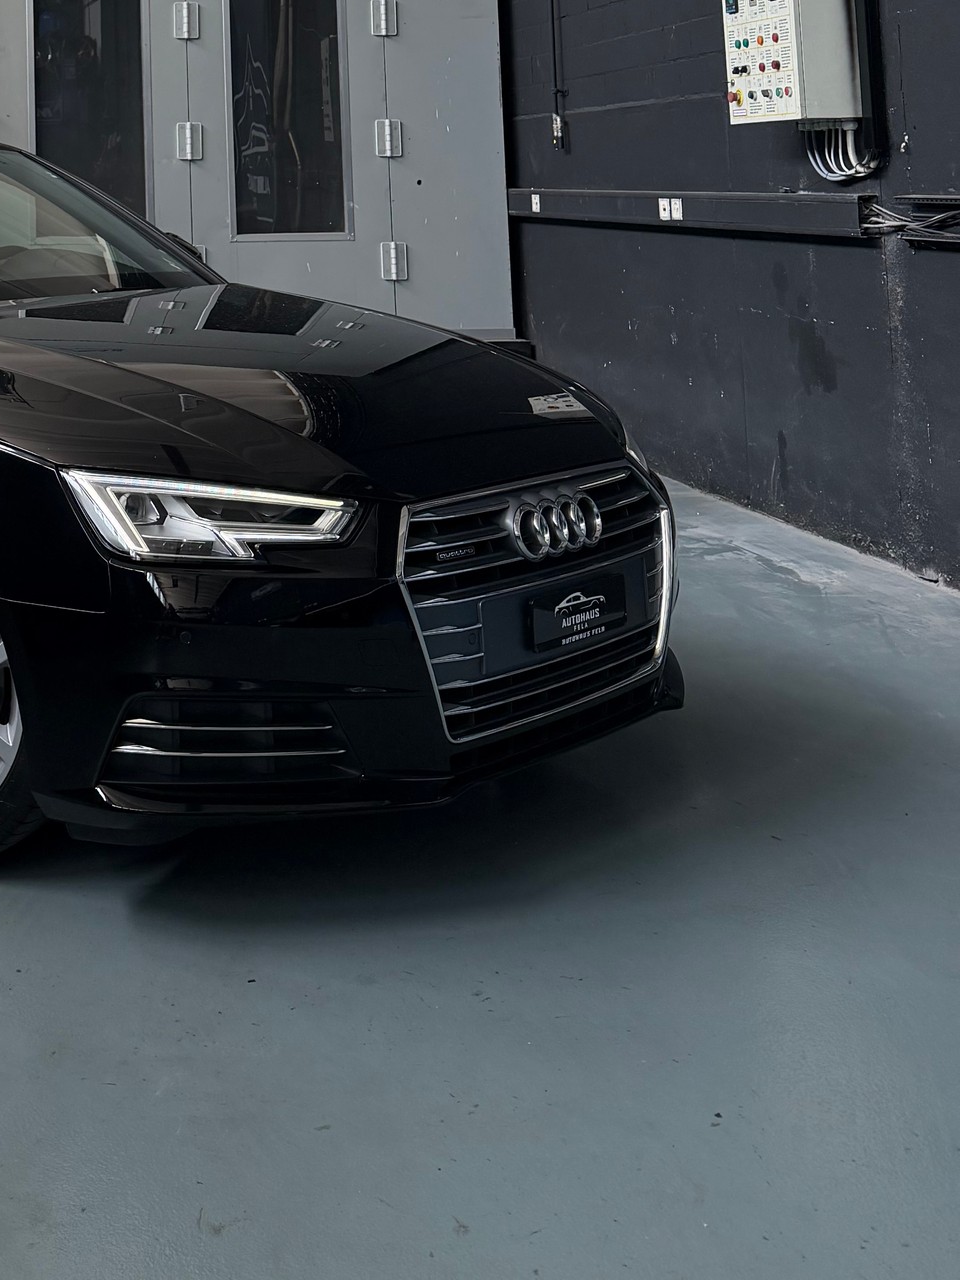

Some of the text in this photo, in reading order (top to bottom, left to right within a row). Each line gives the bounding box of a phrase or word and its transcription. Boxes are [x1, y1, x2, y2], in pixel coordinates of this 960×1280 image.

[439, 548, 474, 559] quattro
[561, 608, 600, 629] AUTOHAUS
[573, 622, 588, 632] FELA
